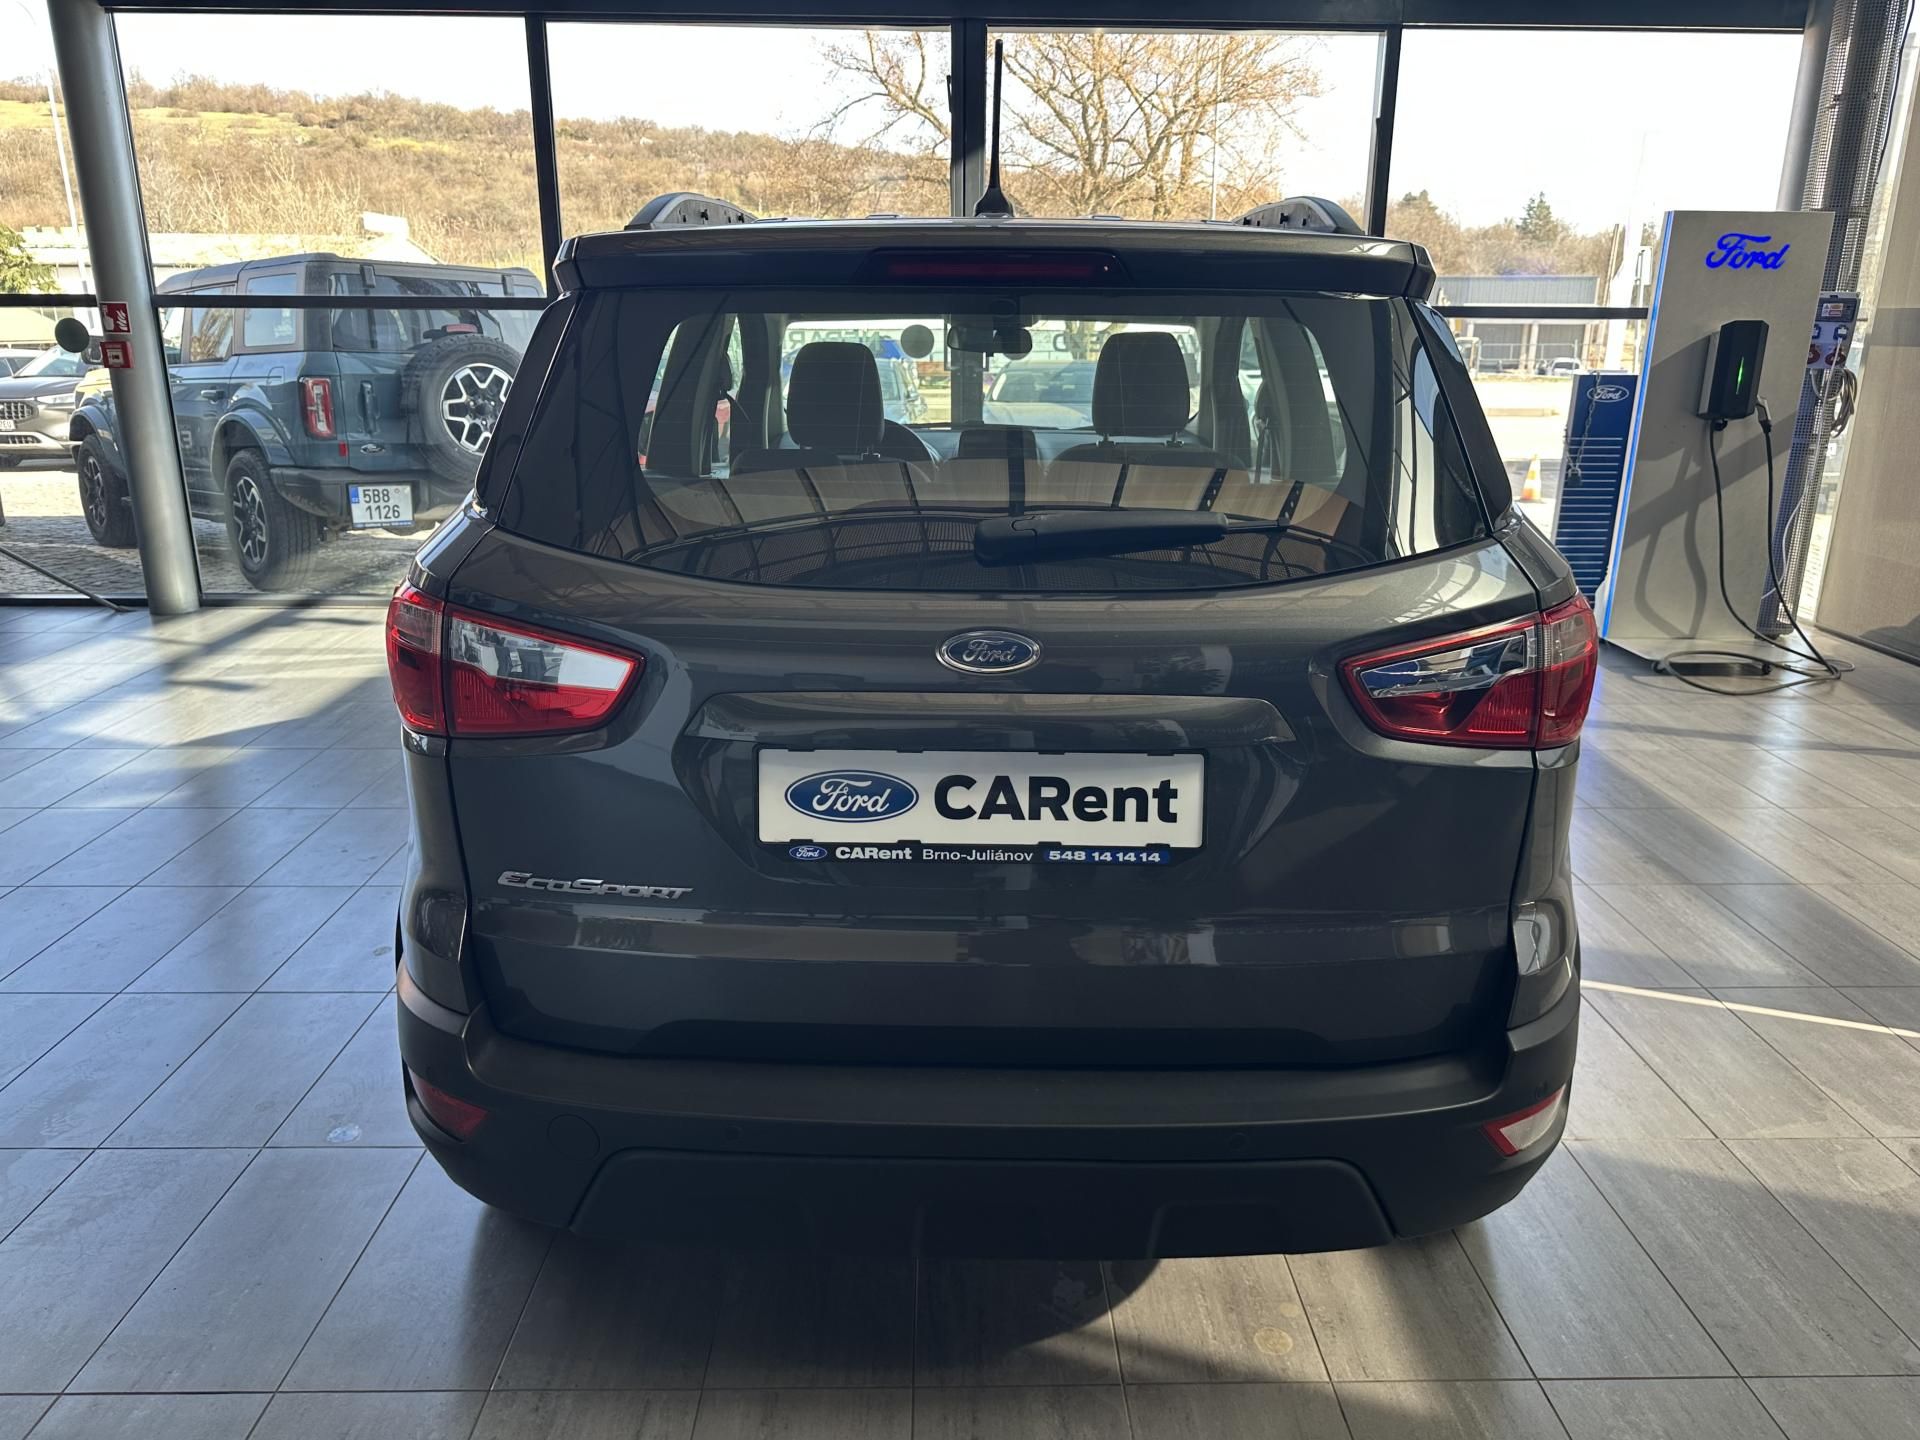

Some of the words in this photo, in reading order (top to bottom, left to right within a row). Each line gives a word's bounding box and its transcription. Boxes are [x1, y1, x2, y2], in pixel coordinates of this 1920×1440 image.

[1705, 233, 1790, 269] Ford
[1594, 387, 1623, 400] Ford
[362, 488, 391, 504] 5B8
[365, 504, 401, 520] 1126
[962, 639, 1018, 663] Ford
[812, 778, 891, 813] Ford
[933, 774, 1178, 823] CARent
[795, 847, 820, 858] Ford
[835, 846, 913, 860] CARent
[922, 848, 1034, 861] Brno-Juliánov
[1048, 850, 1086, 861] 548
[1092, 851, 1113, 862] 14
[1116, 852, 1136, 863] 14
[1139, 852, 1161, 863] 14
